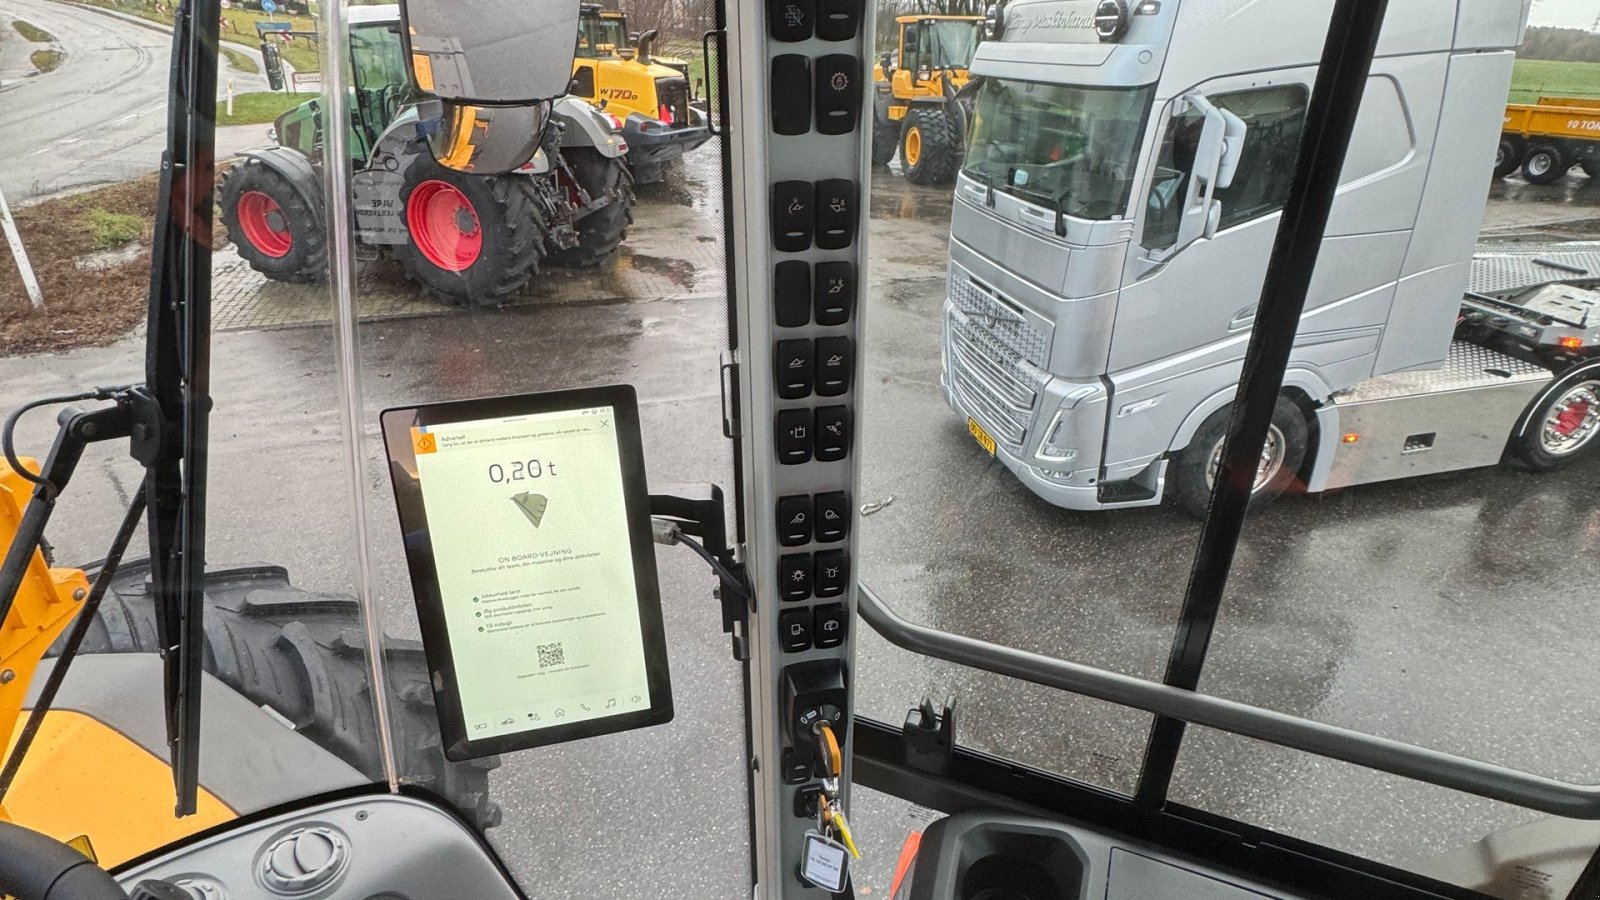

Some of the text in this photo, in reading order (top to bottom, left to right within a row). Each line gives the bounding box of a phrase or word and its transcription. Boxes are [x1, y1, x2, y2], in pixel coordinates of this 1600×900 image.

[1568, 120, 1580, 129] 10
[488, 458, 556, 486] 0,20 t
[498, 547, 572, 563] ON BOARD-VEJNING
